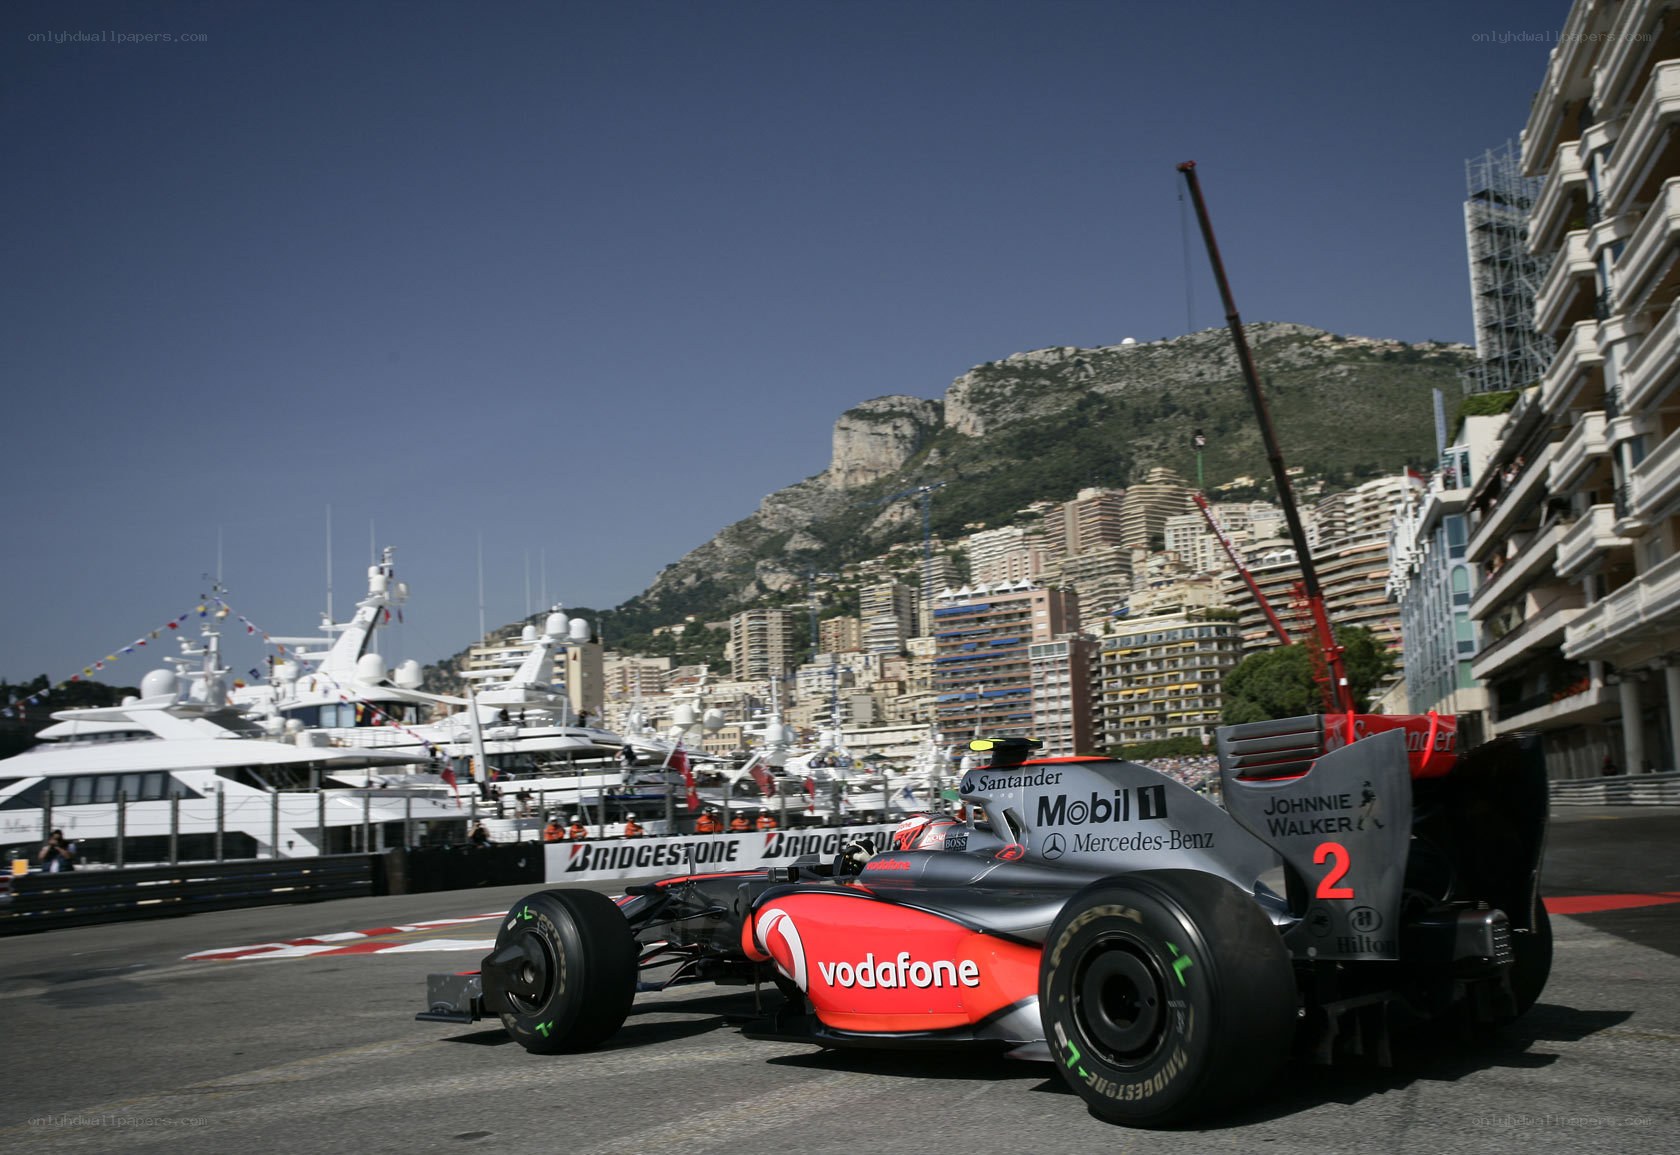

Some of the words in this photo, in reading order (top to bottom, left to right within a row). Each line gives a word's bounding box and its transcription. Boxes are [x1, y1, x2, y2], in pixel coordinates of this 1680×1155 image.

[978, 768, 1063, 792] Santander
[1036, 788, 1131, 827] Mobil
[1264, 794, 1353, 816] JOHNNIE
[1266, 817, 1354, 838] WALKER
[945, 837, 967, 849] BOSS
[1072, 829, 1215, 853] Mercedes-Benz
[565, 839, 740, 873] BRIDGESTONE
[866, 858, 912, 871] vodafone
[1312, 841, 1356, 900] 2
[1336, 934, 1397, 954] Hilton
[817, 951, 981, 989] vodafone
